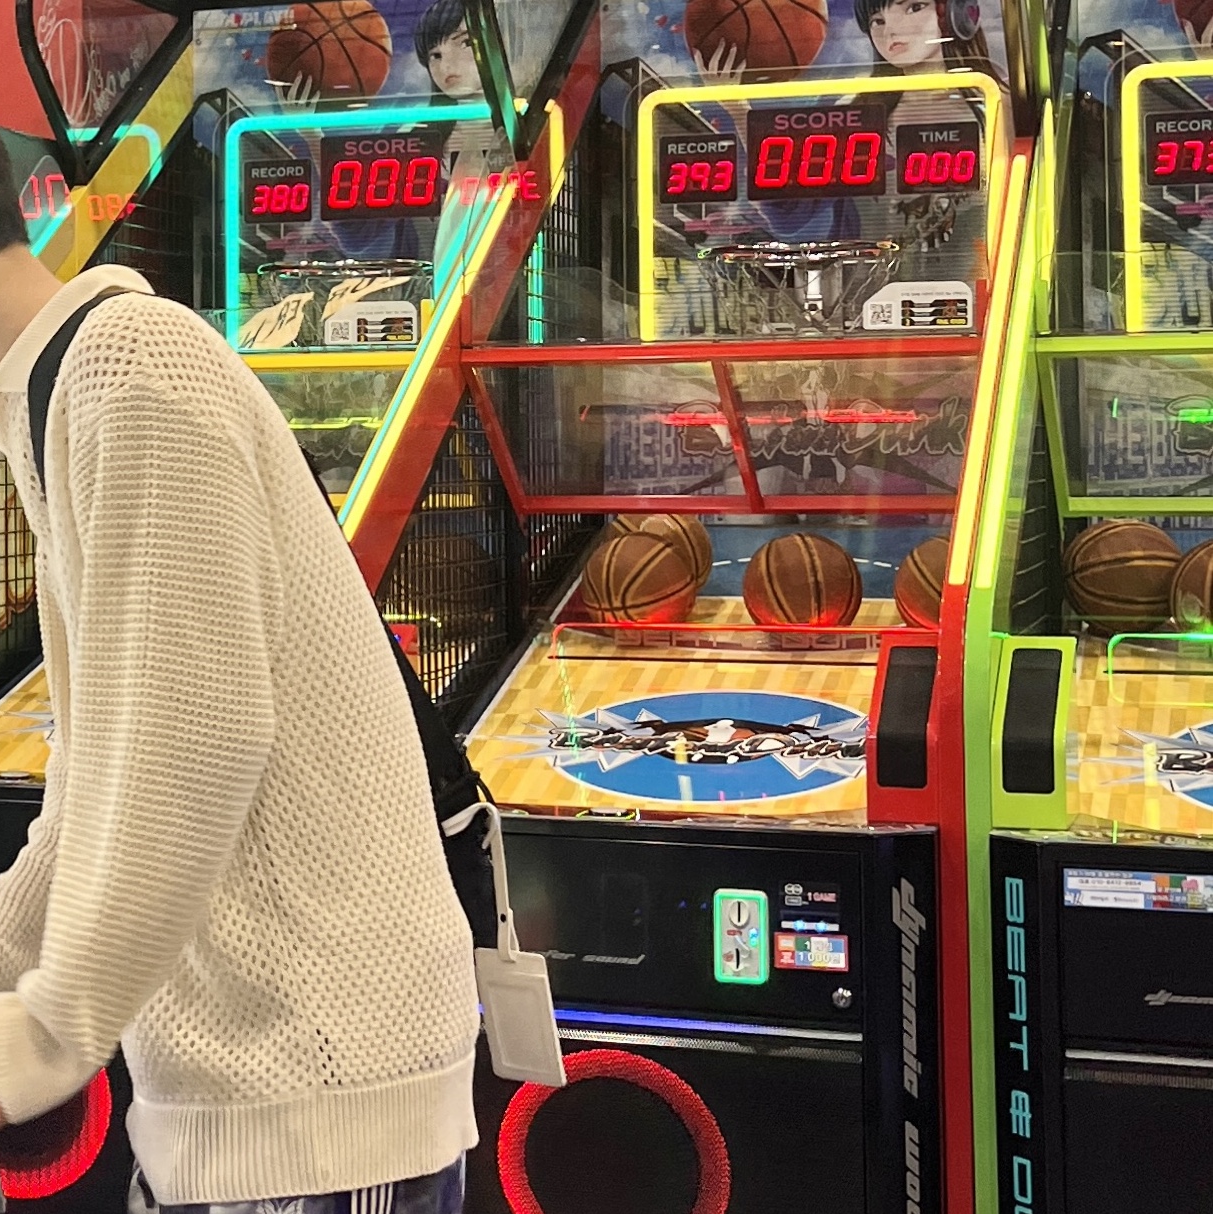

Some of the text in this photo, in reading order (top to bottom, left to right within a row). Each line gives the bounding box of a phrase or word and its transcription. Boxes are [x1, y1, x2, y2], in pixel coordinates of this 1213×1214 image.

[774, 110, 863, 131] SCORE
[1156, 120, 1213, 133] RECOR
[344, 138, 422, 157] SCORE
[667, 141, 729, 156] RECORD
[919, 129, 960, 143] TIME
[251, 166, 304, 178] RECORD
[754, 133, 881, 189] 000
[905, 150, 976, 185] 000
[327, 156, 439, 209] 000
[668, 160, 734, 195] 393
[252, 183, 310, 215] 380
[1005, 876, 1029, 1072] BEAT
